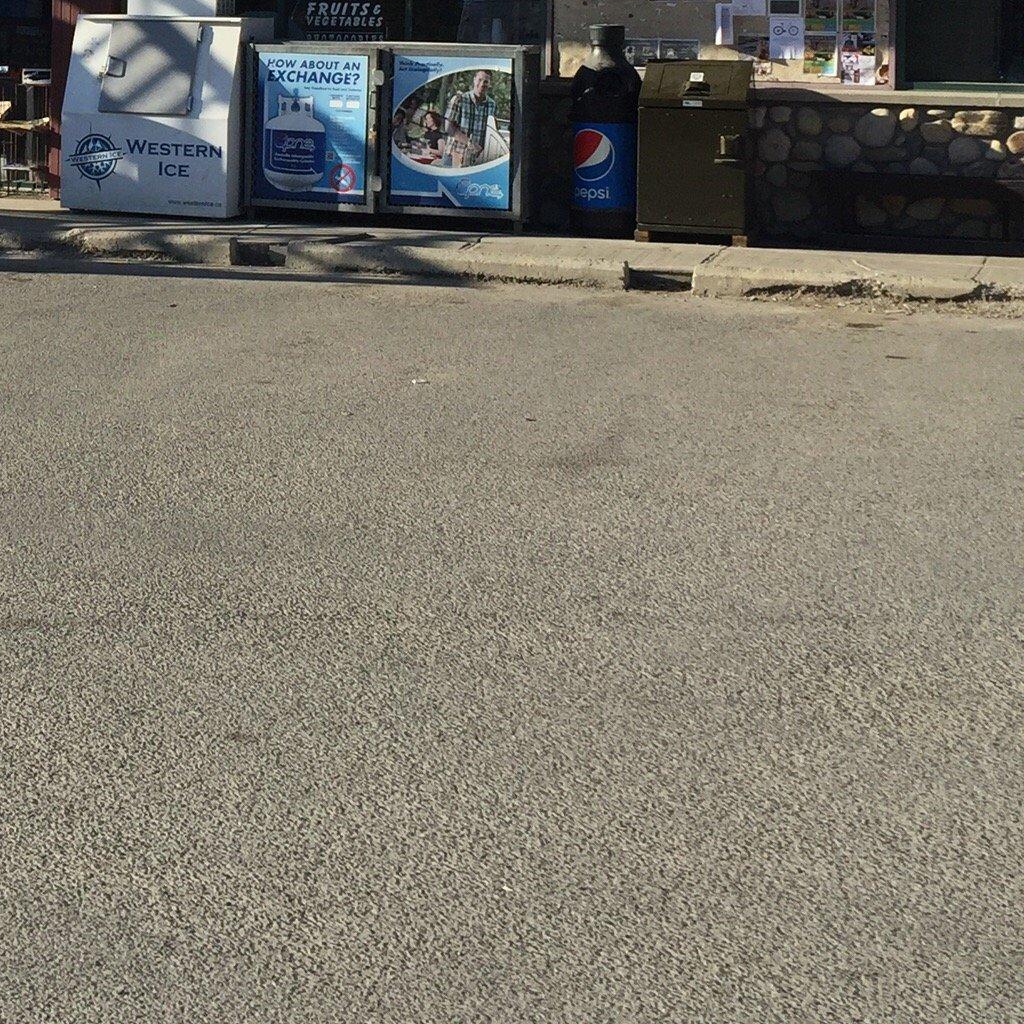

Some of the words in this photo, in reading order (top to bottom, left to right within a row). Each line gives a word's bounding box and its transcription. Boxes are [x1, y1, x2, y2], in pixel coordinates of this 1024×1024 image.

[306, 2, 371, 16] FRUITS
[306, 16, 384, 27] VEGETABLES
[267, 59, 297, 69] HOW
[300, 60, 340, 71] ABOUT
[343, 62, 361, 71] AN
[267, 69, 361, 86] EXCHANGE?
[126, 139, 223, 159] WESTERN
[158, 161, 190, 178] ICE
